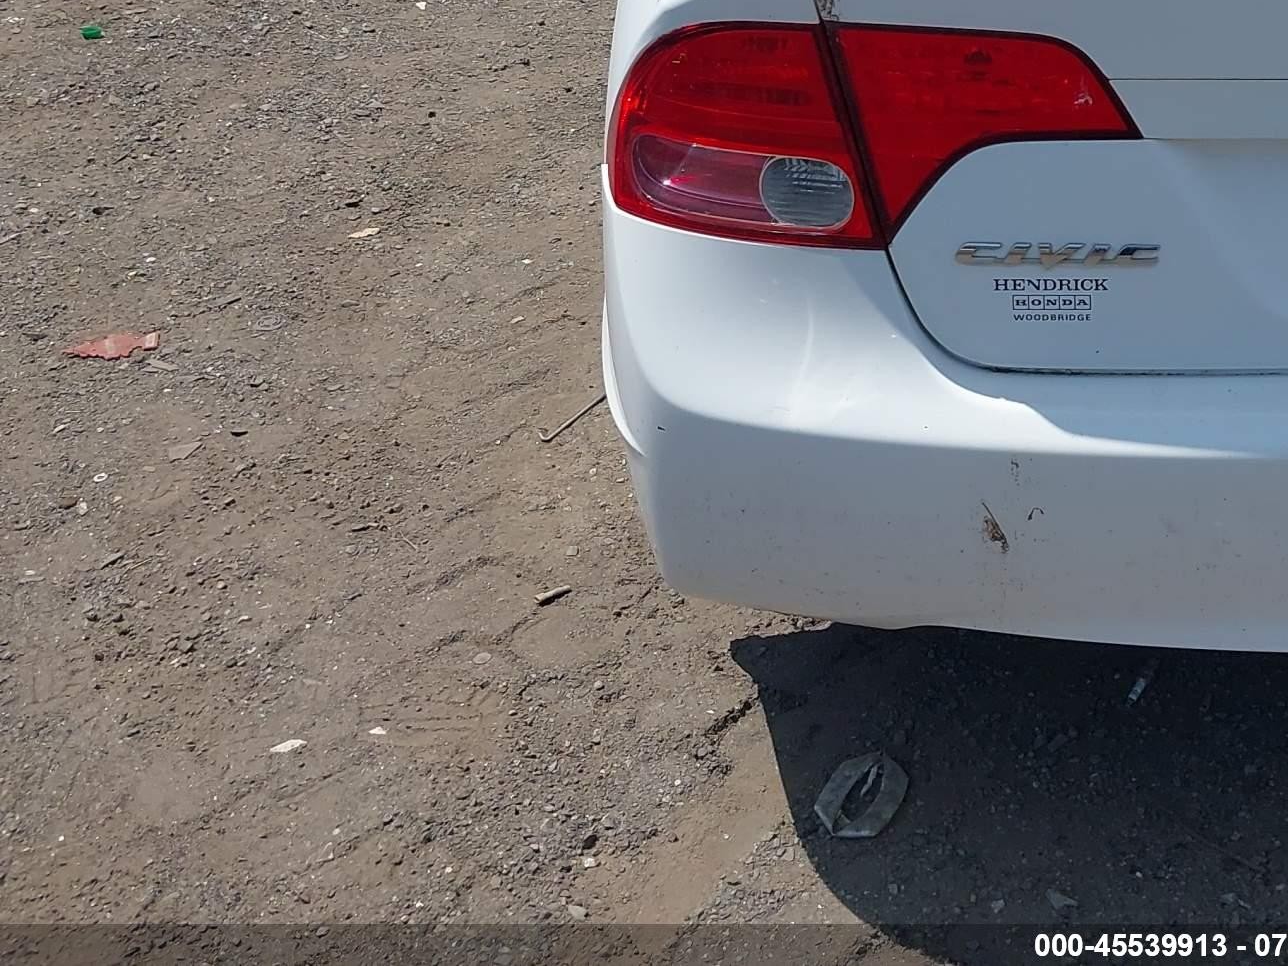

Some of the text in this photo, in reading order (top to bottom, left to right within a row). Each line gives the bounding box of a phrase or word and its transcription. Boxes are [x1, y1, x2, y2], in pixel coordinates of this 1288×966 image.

[955, 241, 1161, 270] CIVIC
[992, 278, 1109, 291] HENDRICK
[1014, 297, 1090, 308] HONDA
[1013, 313, 1092, 322] WOODBRIDGE
